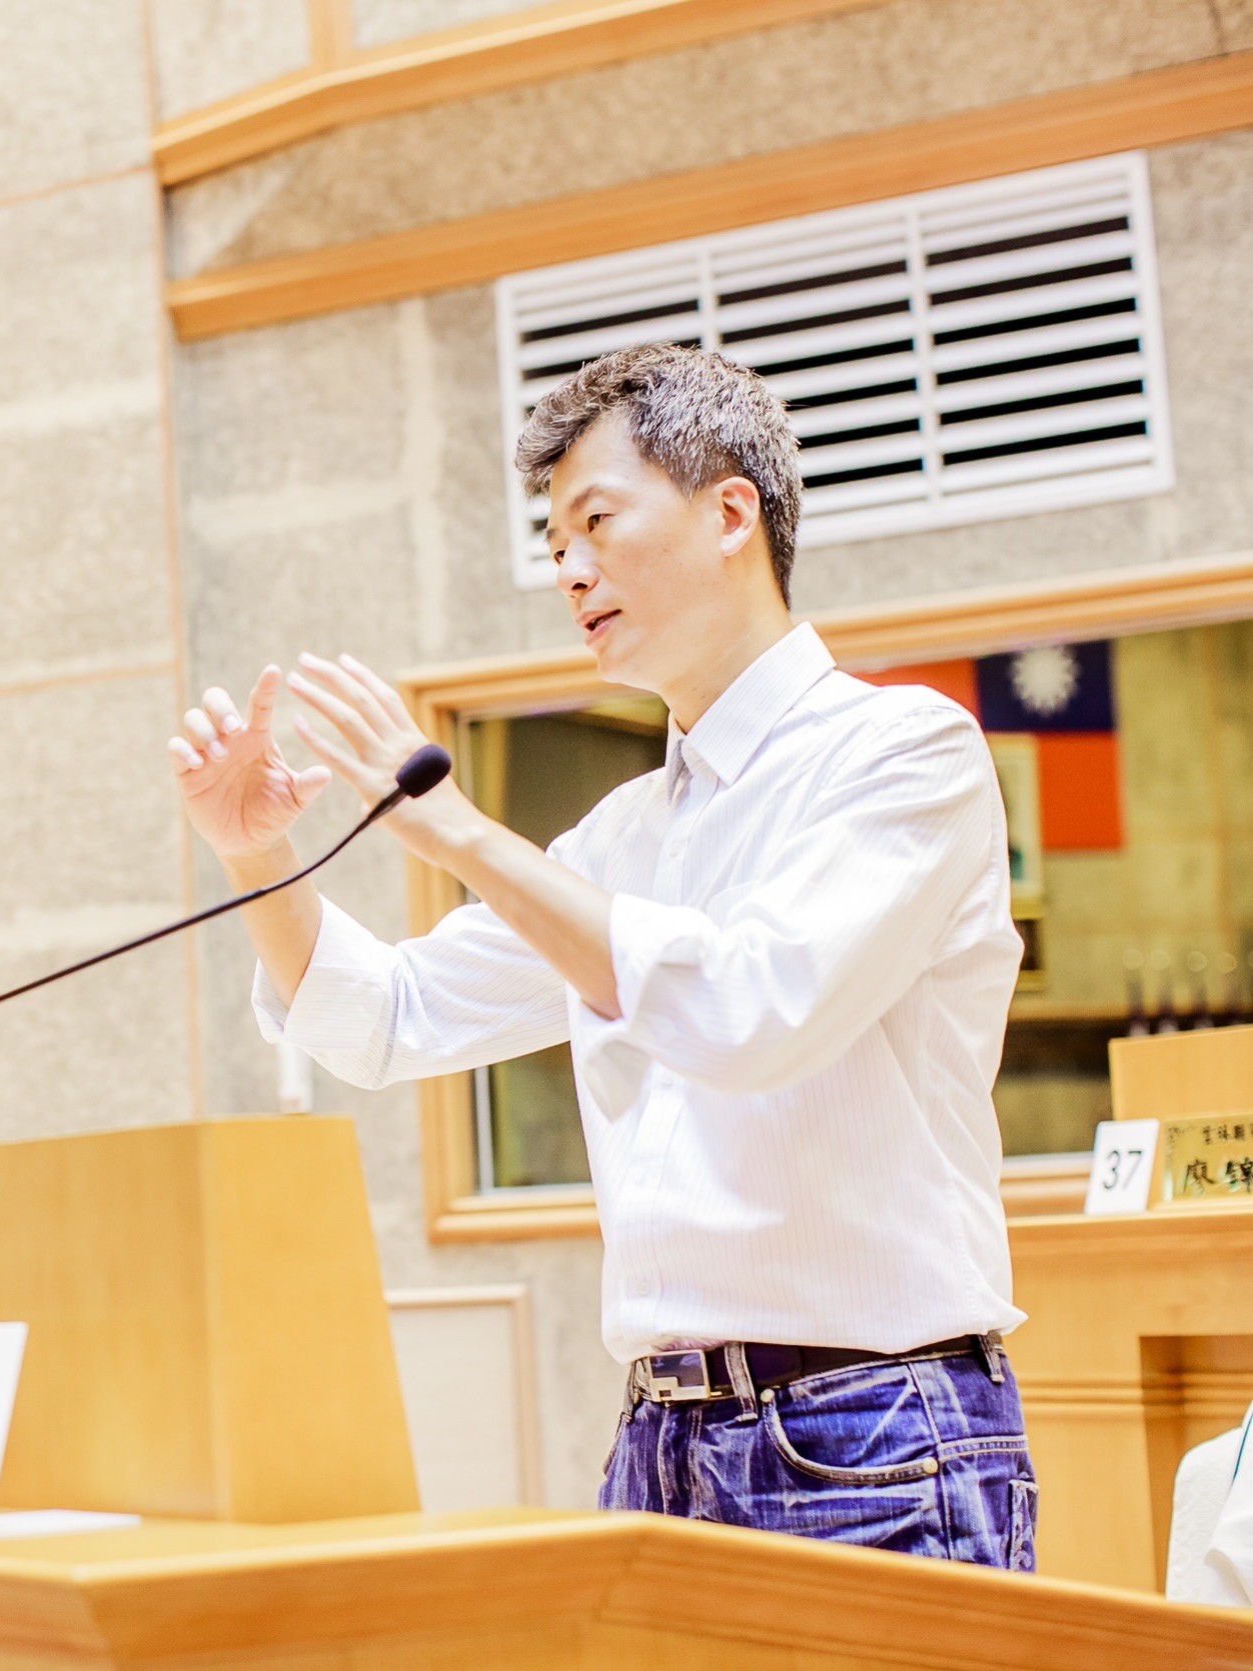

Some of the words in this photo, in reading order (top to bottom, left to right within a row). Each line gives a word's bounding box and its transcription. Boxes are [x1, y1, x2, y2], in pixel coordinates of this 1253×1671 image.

[1203, 1123, 1253, 1145] 雲林縣
[1103, 1150, 1143, 1190] 37
